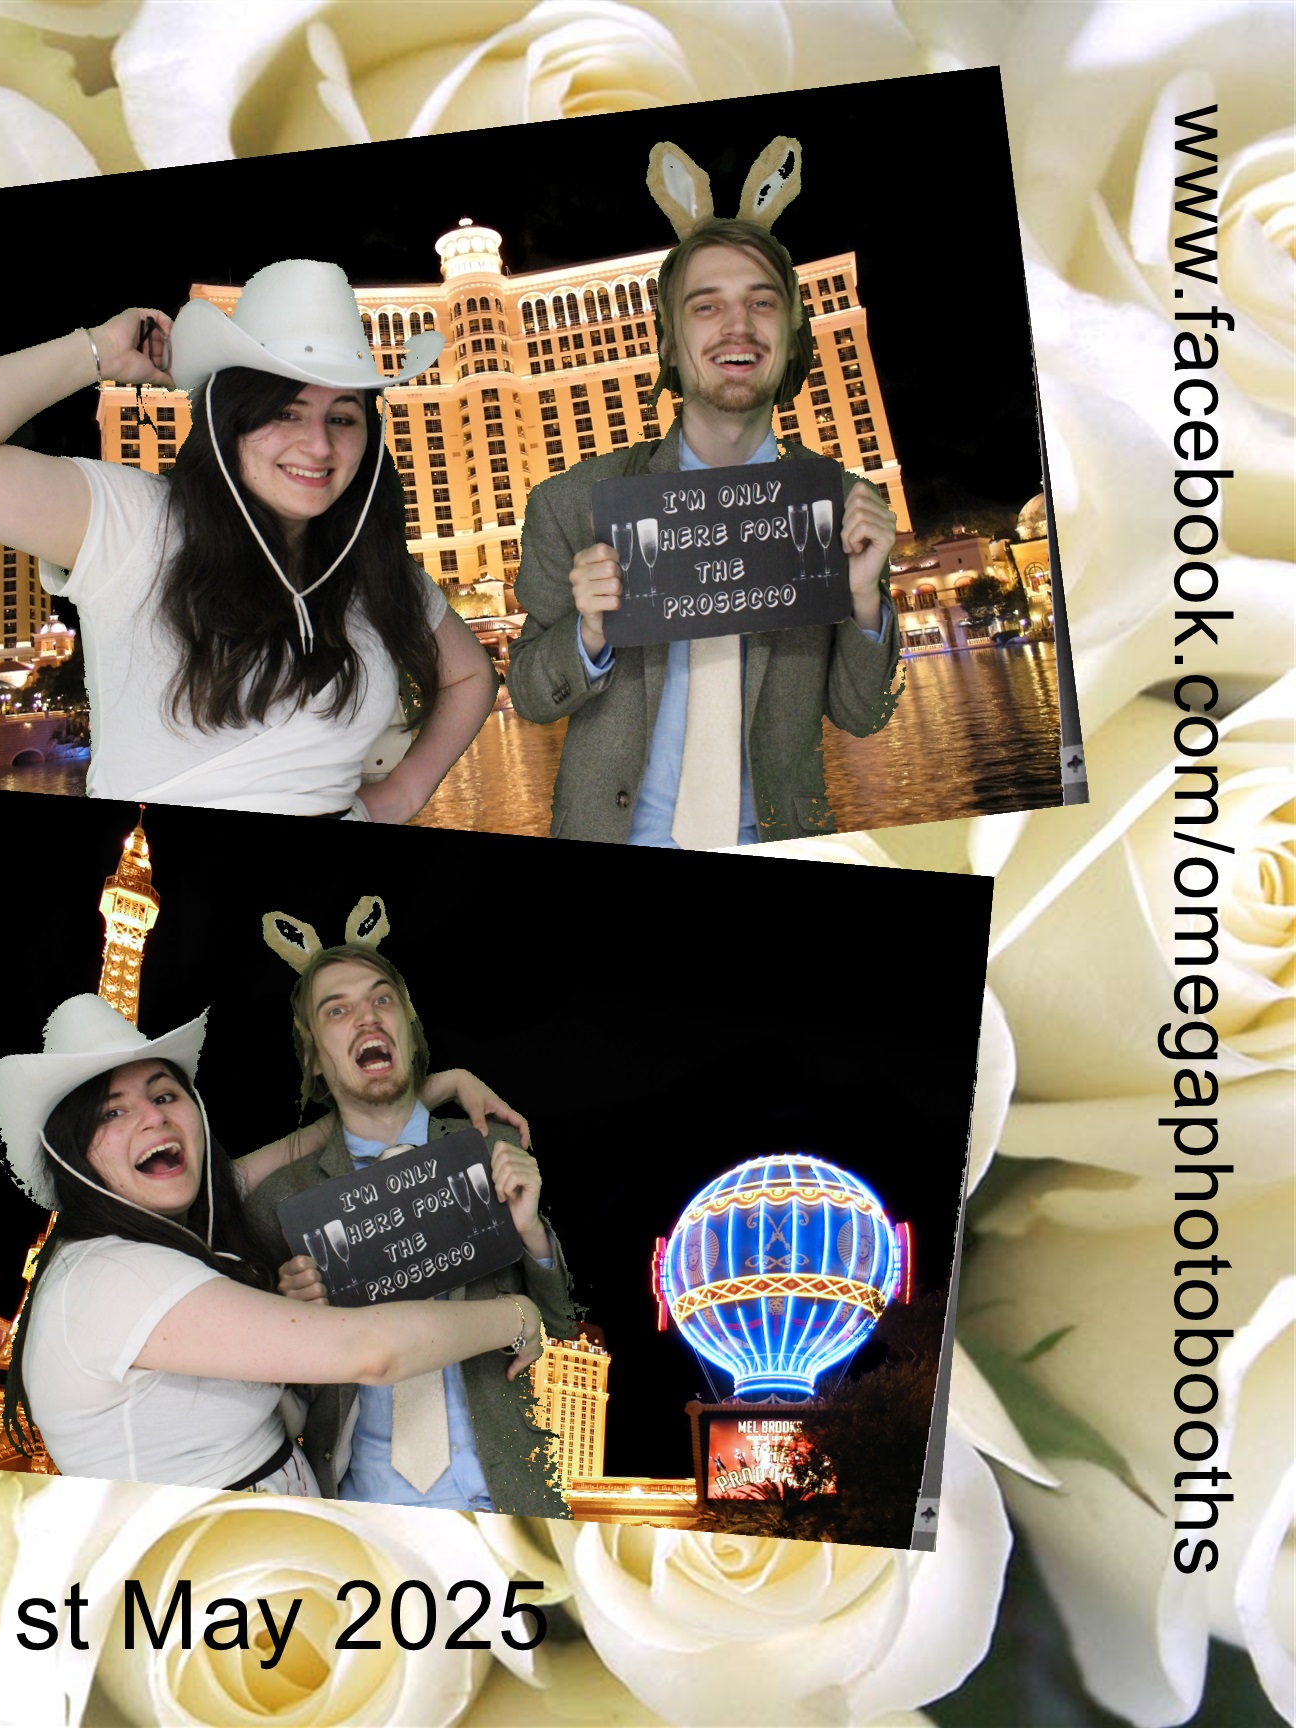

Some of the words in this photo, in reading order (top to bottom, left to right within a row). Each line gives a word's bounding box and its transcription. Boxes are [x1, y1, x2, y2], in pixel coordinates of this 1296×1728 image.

[662, 489, 705, 514] I'M
[718, 480, 781, 508] ONLY
[660, 523, 728, 551] HERE
[740, 517, 788, 542] FOR
[694, 558, 745, 584] THE
[664, 584, 797, 619] PROSECCO
[339, 1183, 378, 1212] I'M
[386, 1159, 437, 1194] ONLY
[346, 1207, 405, 1244] HERE
[412, 1188, 454, 1218] FOR
[383, 1232, 427, 1262] THE
[365, 1242, 475, 1300] PROSECCO
[738, 1420, 759, 1434] MEL
